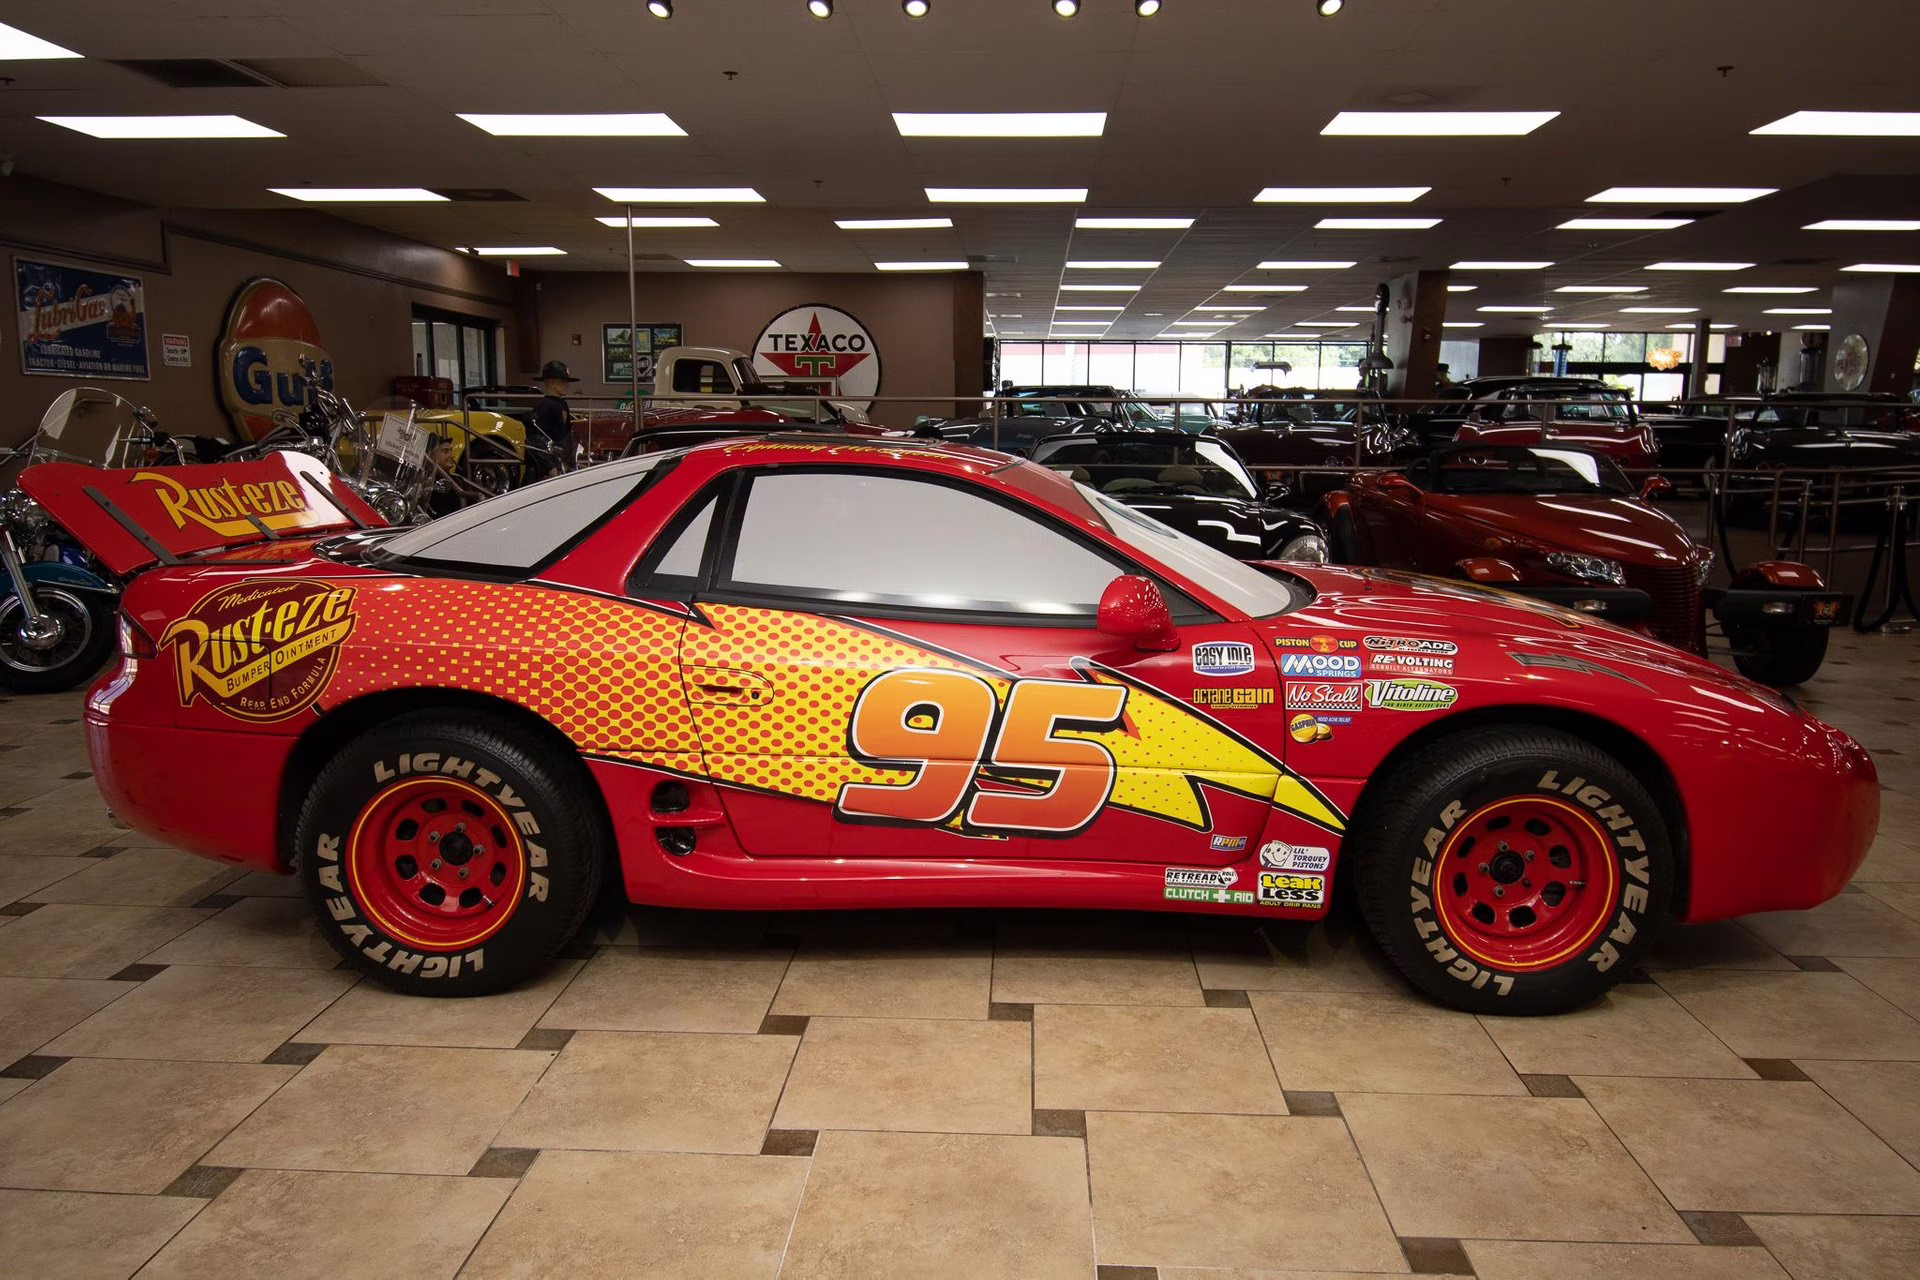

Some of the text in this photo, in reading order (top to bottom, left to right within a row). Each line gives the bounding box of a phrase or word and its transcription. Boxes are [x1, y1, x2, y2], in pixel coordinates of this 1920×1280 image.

[768, 334, 865, 352] TEXACO
[218, 583, 300, 612] Medicated
[1275, 638, 1357, 648] PISTON CUP
[227, 628, 338, 692] BUMPER OINTMENT
[1283, 655, 1360, 674] MOOD
[1373, 654, 1453, 668] RE-VOLTING
[1403, 666, 1452, 674] ALTERNATORS
[271, 695, 291, 709] END
[291, 656, 328, 697] FORMULA
[1288, 684, 1359, 703] No Stall
[1369, 681, 1456, 706] Vitoline
[833, 667, 1129, 839] 95
[374, 753, 549, 902] LIGHTYEAR
[1292, 855, 1328, 863] TORQUEY
[1166, 872, 1217, 881] RETREAD
[1537, 770, 1649, 972] LIGHTYEAR
[317, 833, 484, 978] LIGHTYEAR
[1165, 888, 1254, 902] CLUTCH AID
[1411, 800, 1515, 996] LIGHTYEAR
